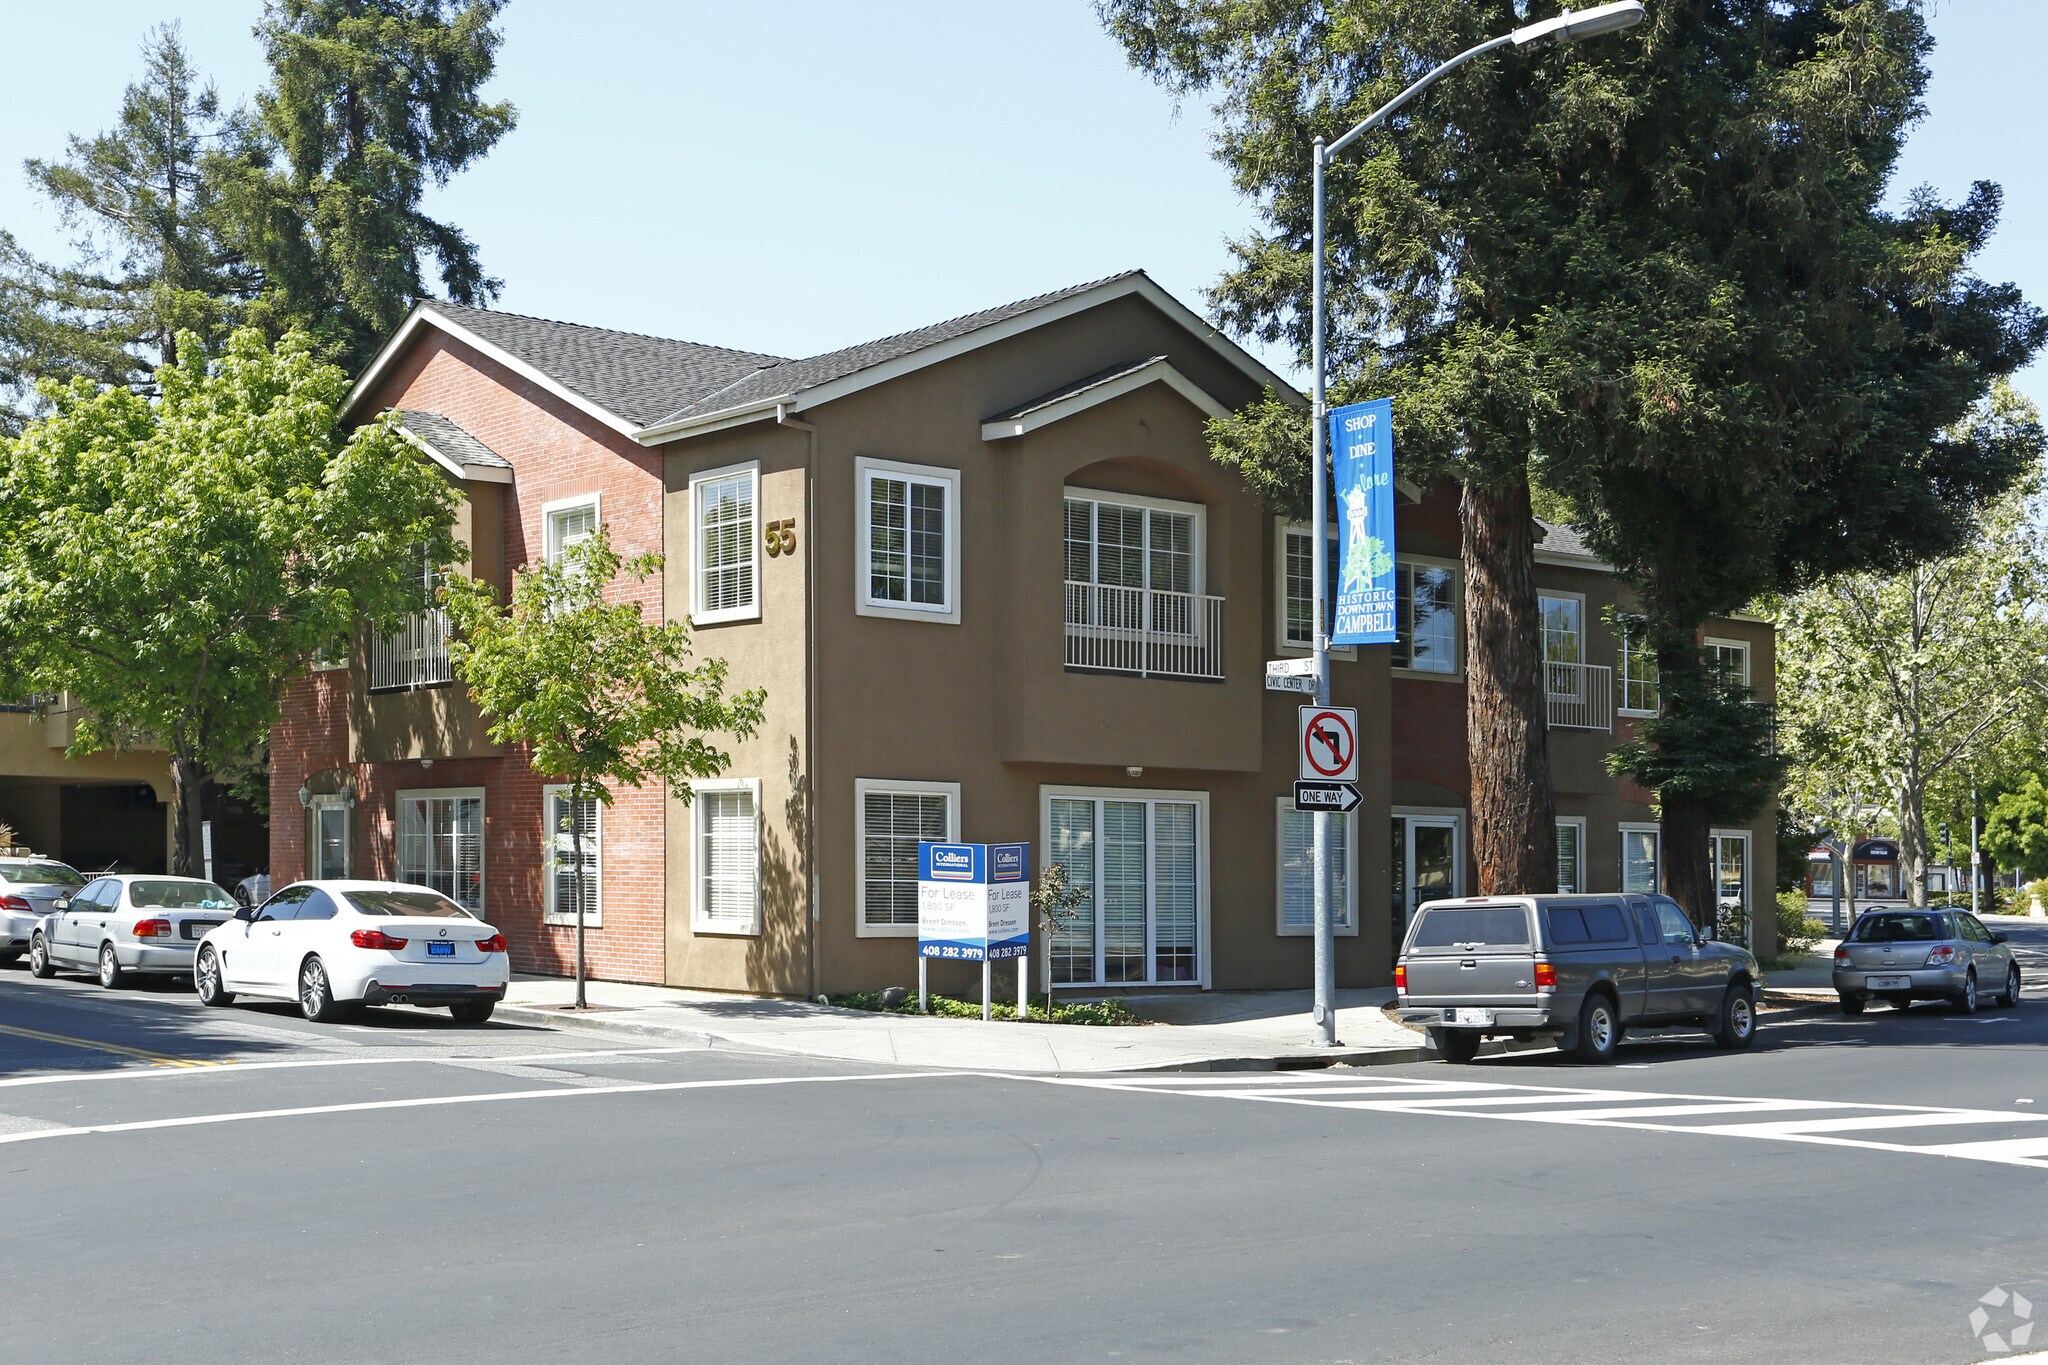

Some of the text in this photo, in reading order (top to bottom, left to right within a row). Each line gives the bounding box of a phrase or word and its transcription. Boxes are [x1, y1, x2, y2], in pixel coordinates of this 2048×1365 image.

[1345, 414, 1376, 432] SHOP
[1349, 441, 1376, 460] DINE
[765, 517, 797, 558] 55
[1338, 590, 1395, 606] HISTORIC
[1337, 601, 1394, 616] DOWNTOWN
[1336, 612, 1395, 635] CAMPBELL
[1268, 660, 1313, 675] THIRD ST
[1267, 675, 1281, 688] CIVIC
[1283, 677, 1303, 690] CENTER
[1302, 790, 1343, 804] ONE WAY
[935, 851, 969, 863] Colliers
[997, 853, 1019, 864] Colliers
[921, 886, 975, 901] For Lease
[988, 888, 1022, 901] For Lease
[944, 902, 955, 912] SF
[1002, 903, 1010, 913] SF
[922, 917, 967, 926] Brent Dressen
[1000, 919, 1017, 927] Dressen
[431, 946, 451, 954] BMW
[922, 945, 983, 959] 408 282 3979
[988, 945, 1027, 959] 408 282 3979
